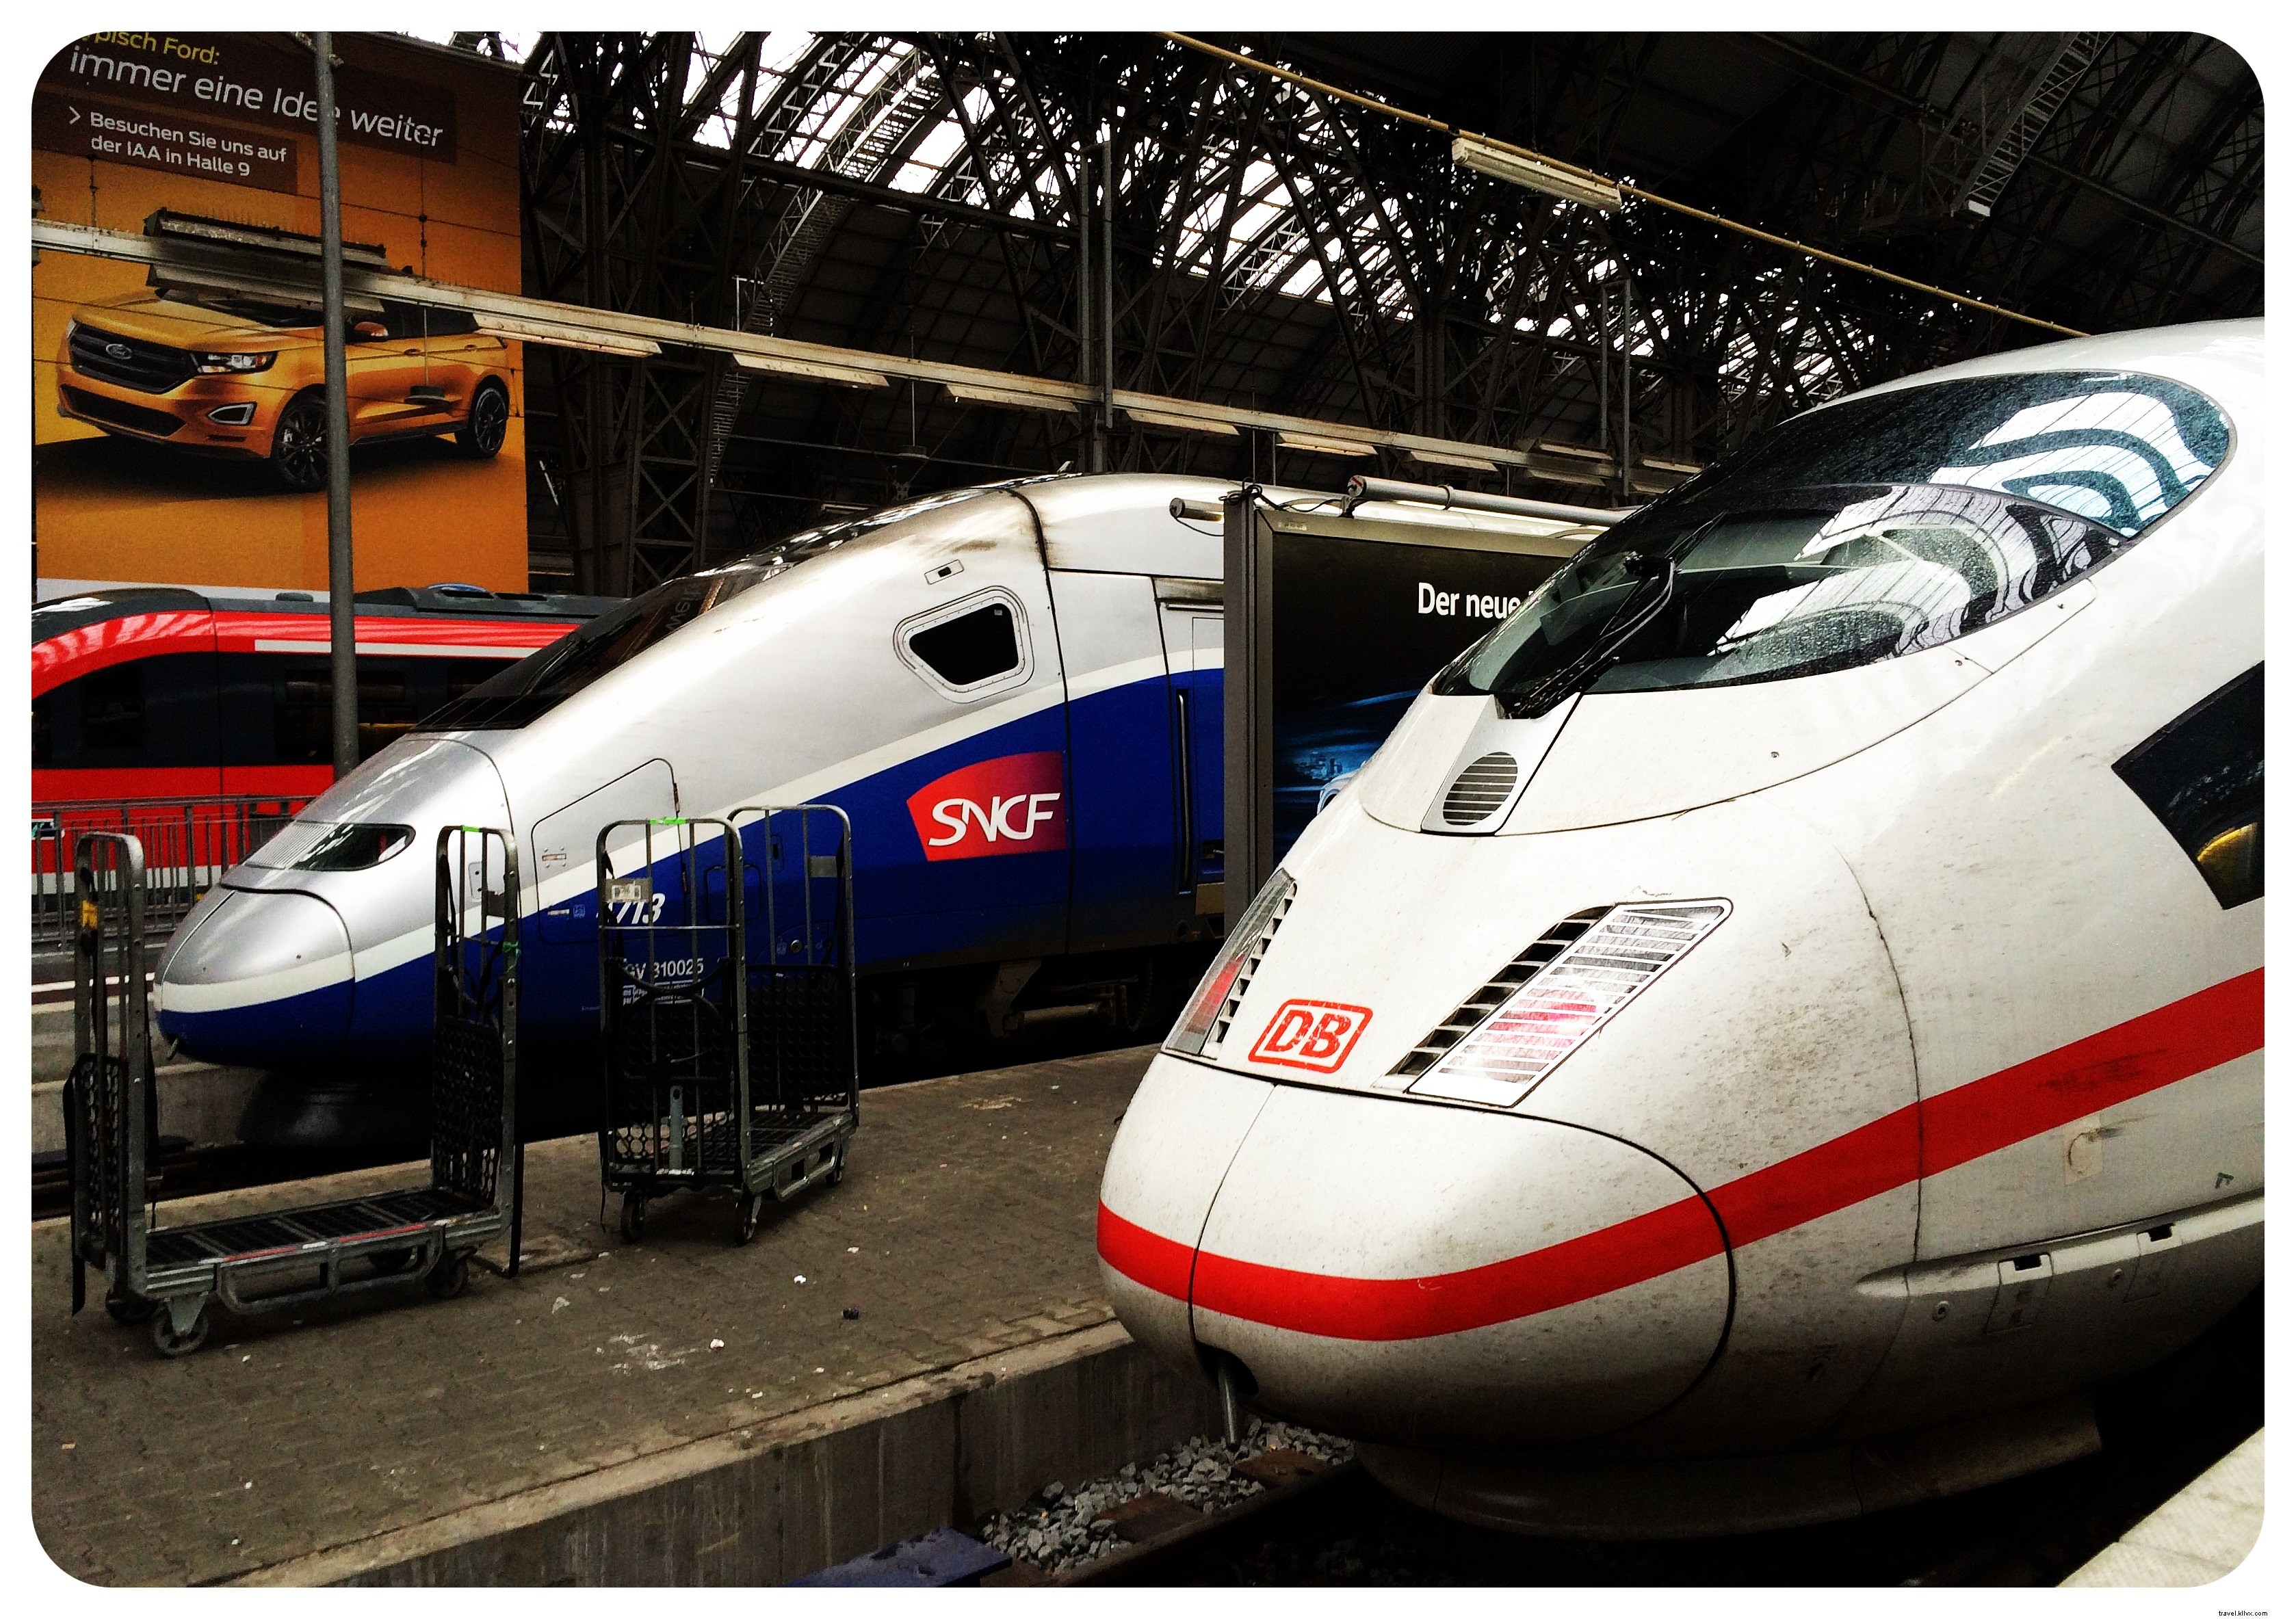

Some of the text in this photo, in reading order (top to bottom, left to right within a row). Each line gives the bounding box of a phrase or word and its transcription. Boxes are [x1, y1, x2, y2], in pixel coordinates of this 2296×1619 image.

[82, 31, 220, 64] pisch Ford:
[70, 45, 186, 92] immer
[194, 76, 263, 109] eine
[351, 109, 443, 146] weiter
[90, 111, 287, 162] Besuchen Sie uns auf
[91, 135, 250, 176] der IAA in Halle 9
[1418, 582, 1460, 616] Der
[928, 793, 1060, 846] SNCF
[596, 893, 666, 924] 713
[1264, 1010, 1351, 1058] DB
